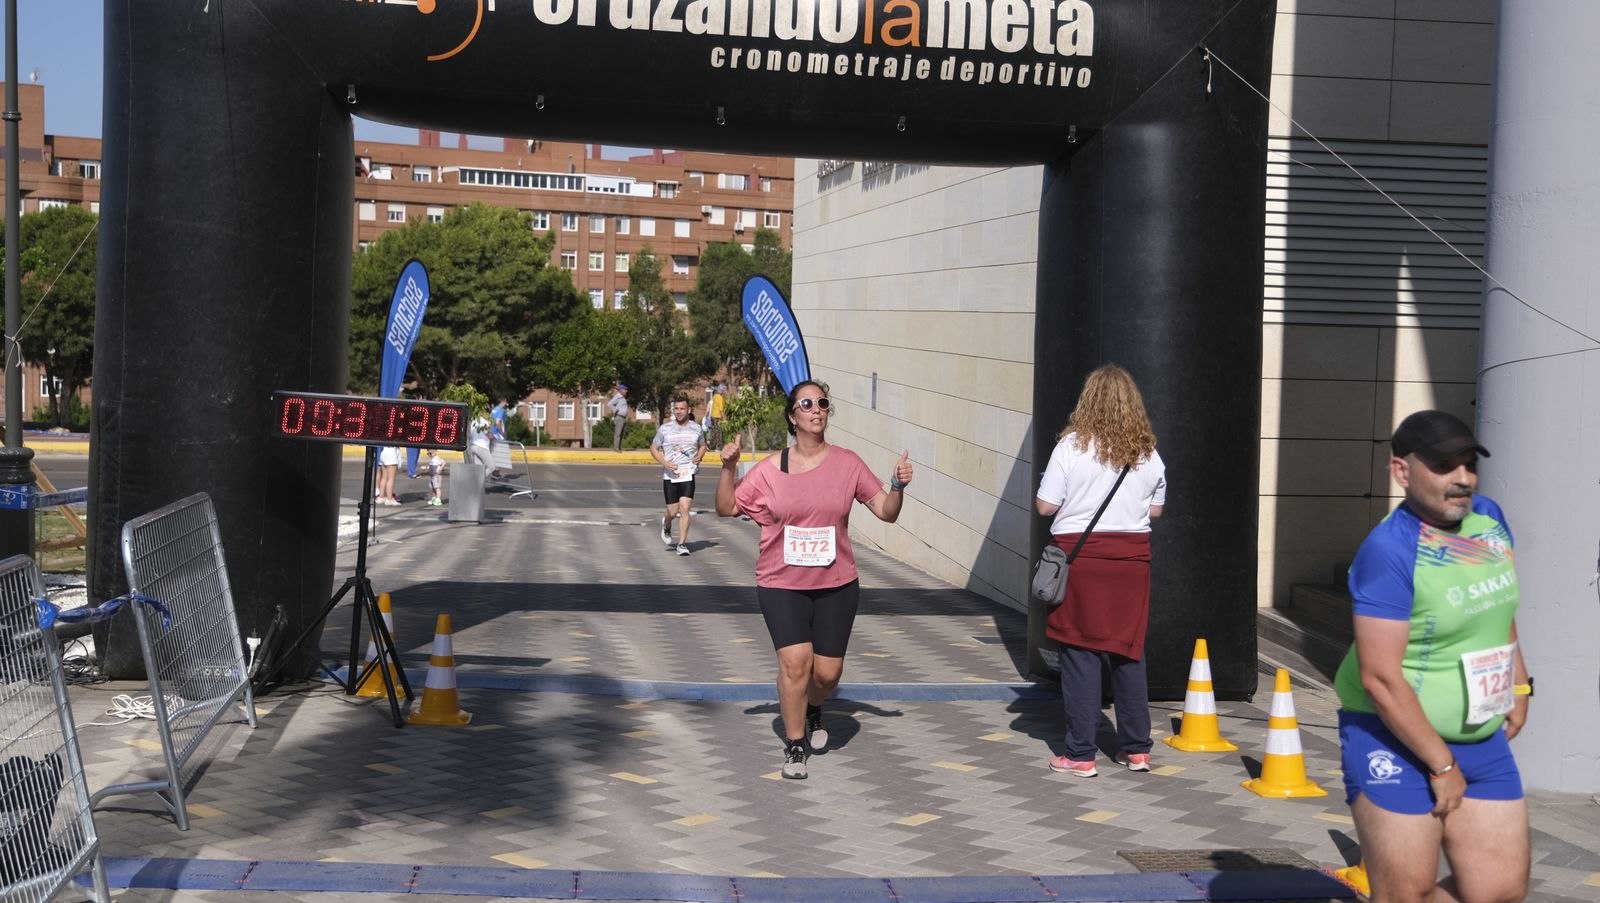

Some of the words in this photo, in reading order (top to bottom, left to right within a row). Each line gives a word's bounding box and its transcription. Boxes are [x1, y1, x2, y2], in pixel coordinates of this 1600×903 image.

[711, 46, 931, 81] cronometraje
[940, 56, 1093, 88] deportivo
[790, 540, 829, 552] 1172
